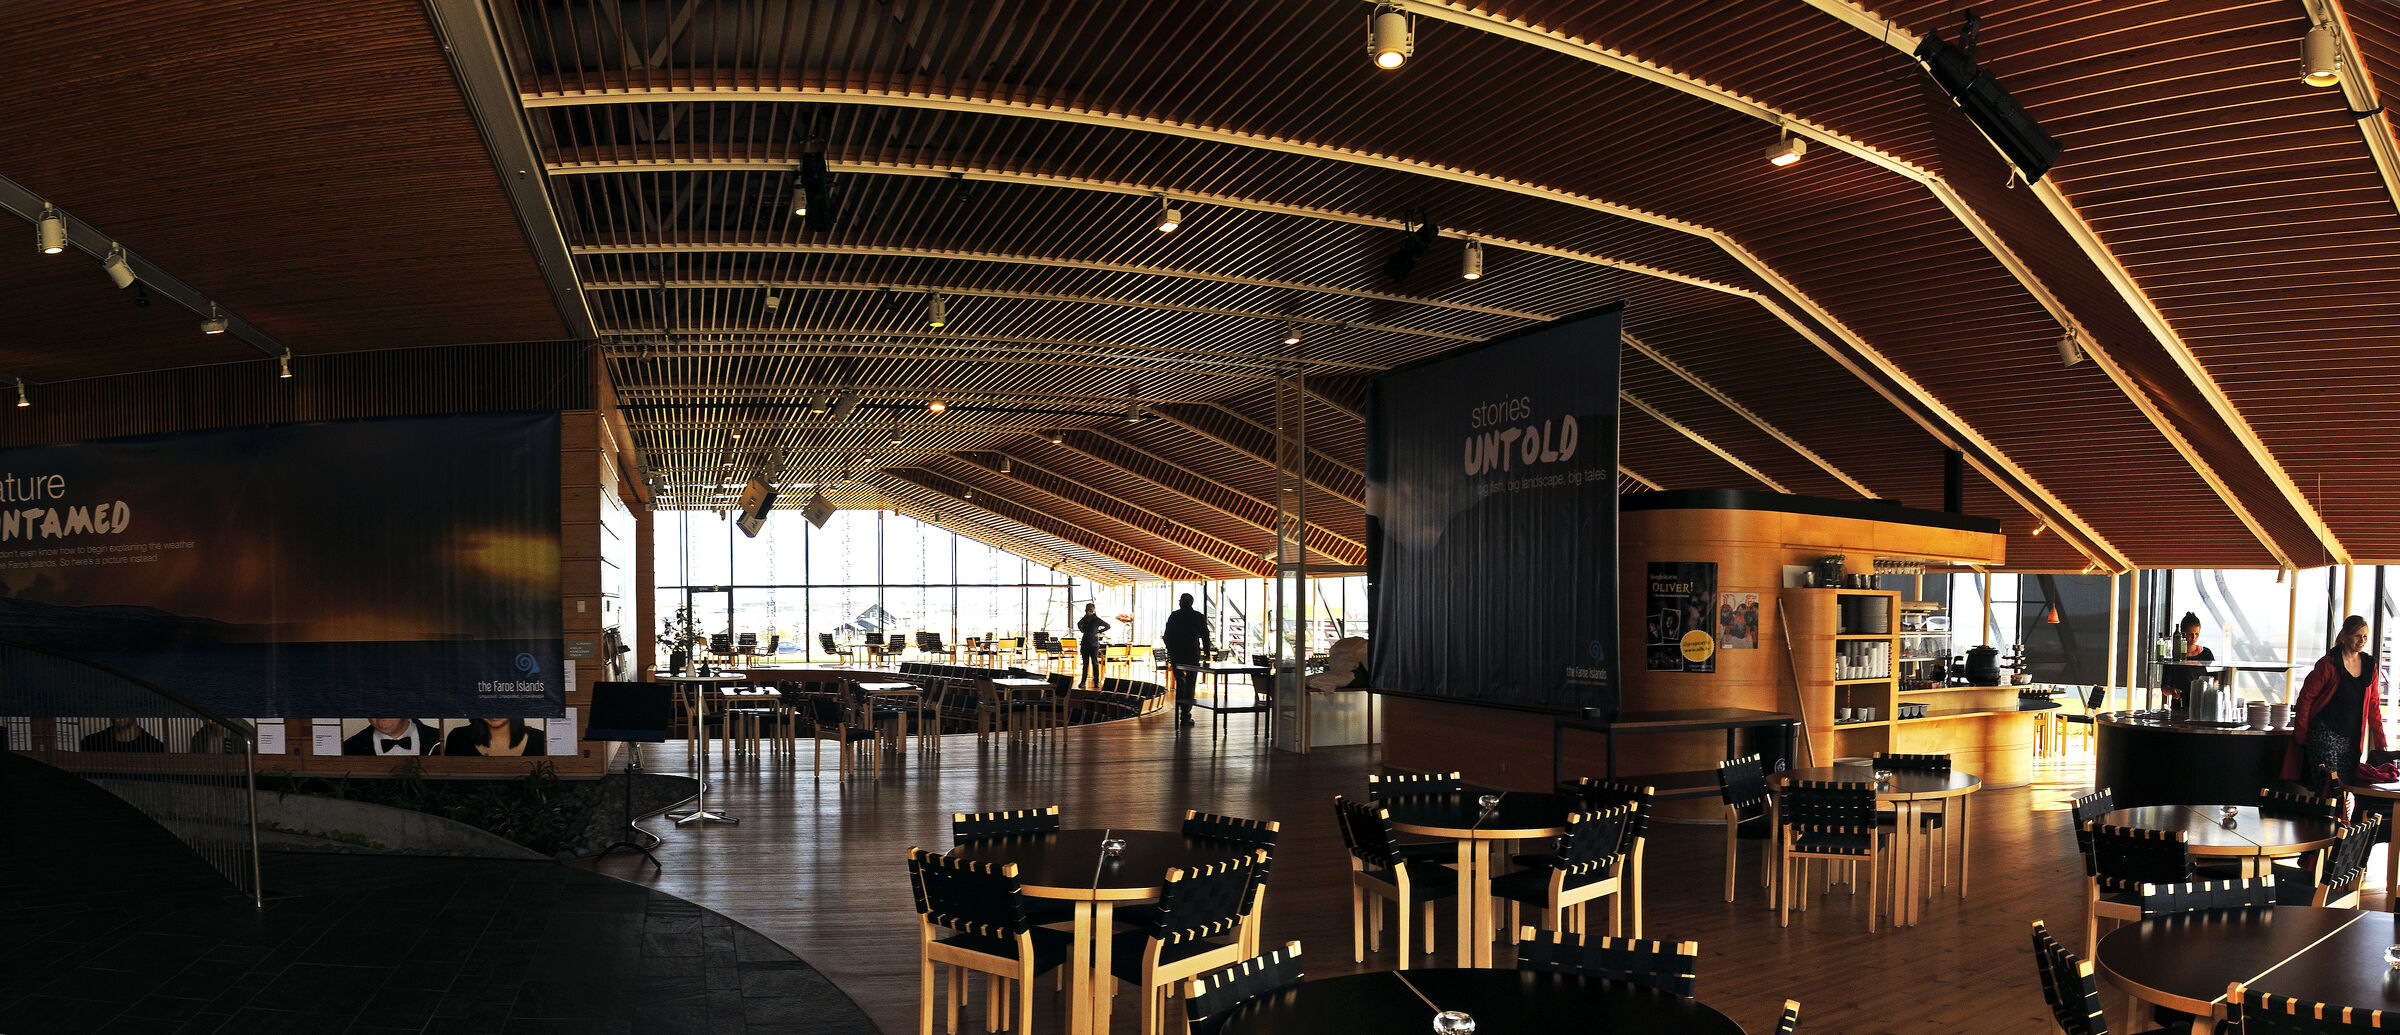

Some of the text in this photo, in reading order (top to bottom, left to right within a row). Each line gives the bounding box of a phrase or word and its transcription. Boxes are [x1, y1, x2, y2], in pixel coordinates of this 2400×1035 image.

[1471, 393, 1530, 428] stories
[1464, 414, 1578, 476] UNTOLD
[1568, 470, 1582, 486] big
[0, 500, 130, 541] NTAMED
[77, 546, 86, 555] to
[87, 544, 108, 555] begin
[109, 542, 148, 553] explaining
[148, 541, 162, 550] the
[163, 540, 196, 550] weather
[60, 558, 70, 567] So
[102, 555, 128, 566] picture
[1652, 581, 1694, 594] OLIVER!
[478, 680, 545, 692] the Faroe Islands
